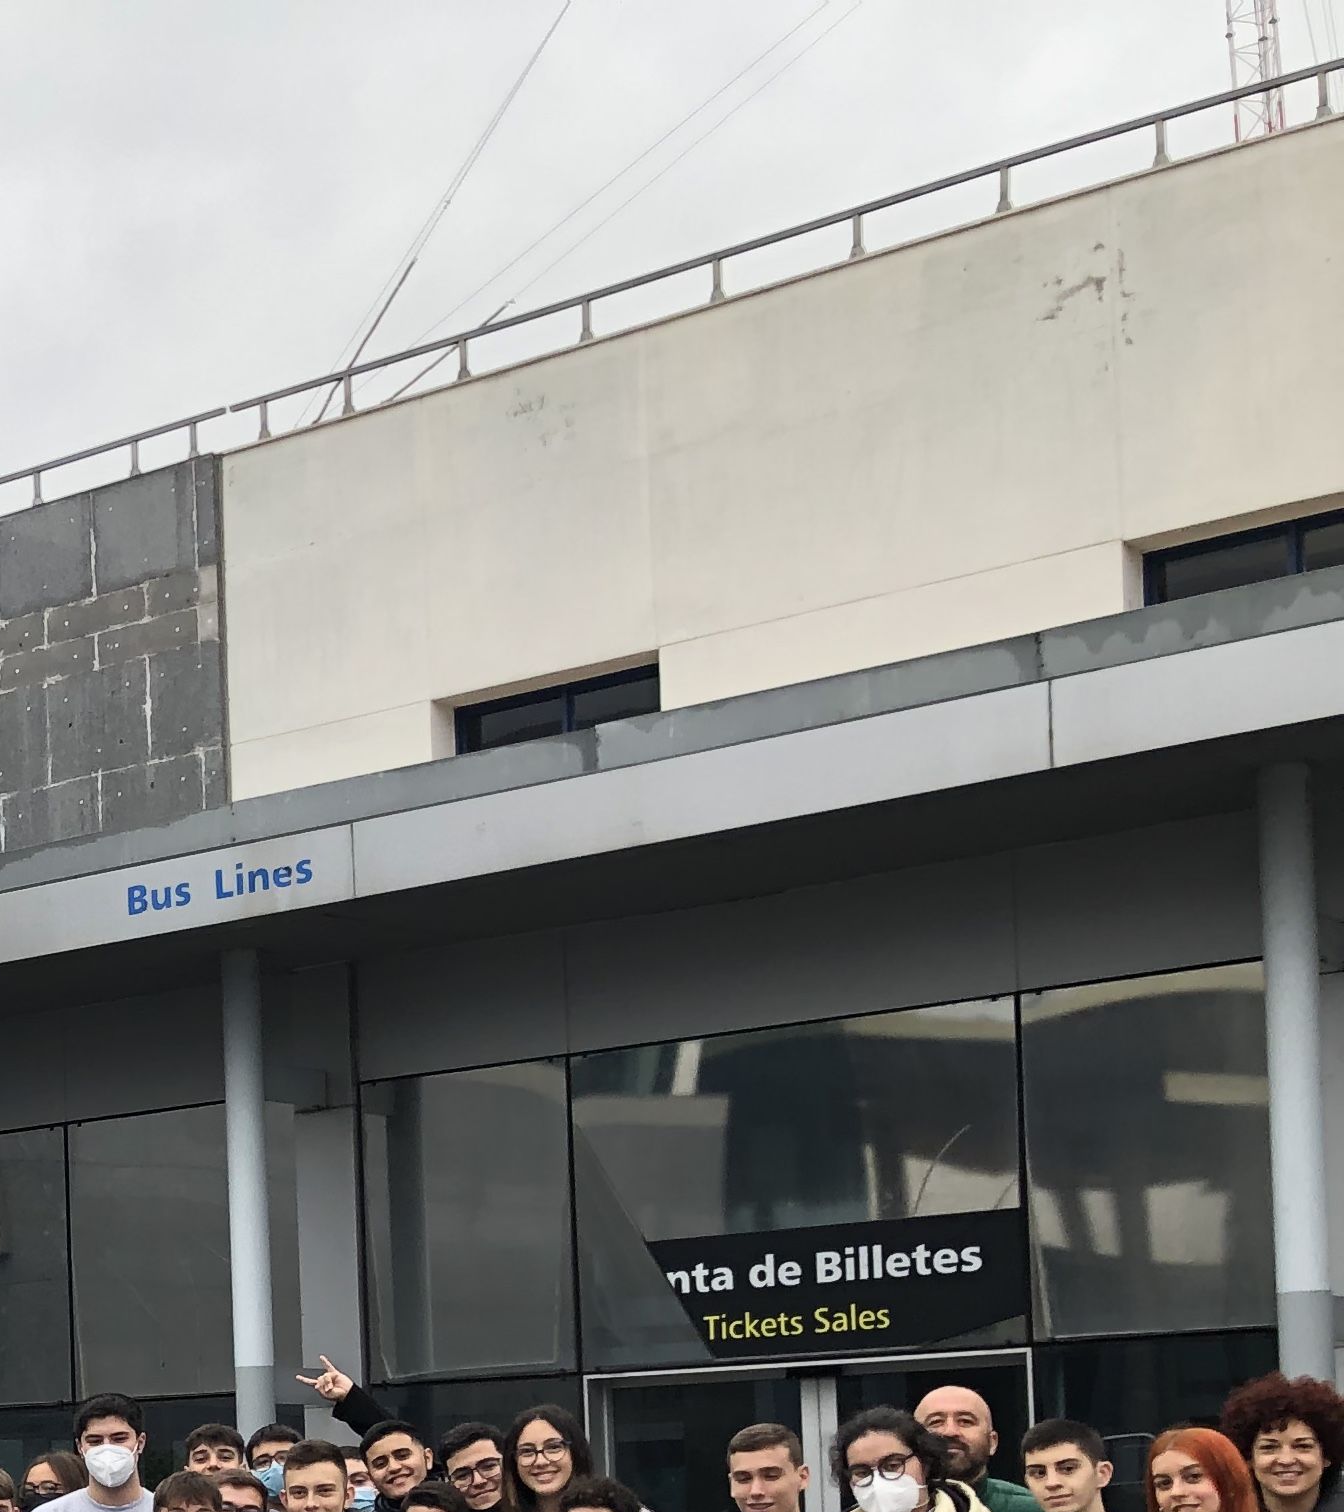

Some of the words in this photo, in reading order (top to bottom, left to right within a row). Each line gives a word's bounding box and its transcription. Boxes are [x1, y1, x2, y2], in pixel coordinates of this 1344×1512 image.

[127, 881, 191, 916] Bus
[215, 859, 313, 900] Lines
[749, 1253, 802, 1289] de
[815, 1243, 983, 1284] Billetes
[703, 1311, 804, 1341] Tickets
[814, 1303, 890, 1334] Sales
